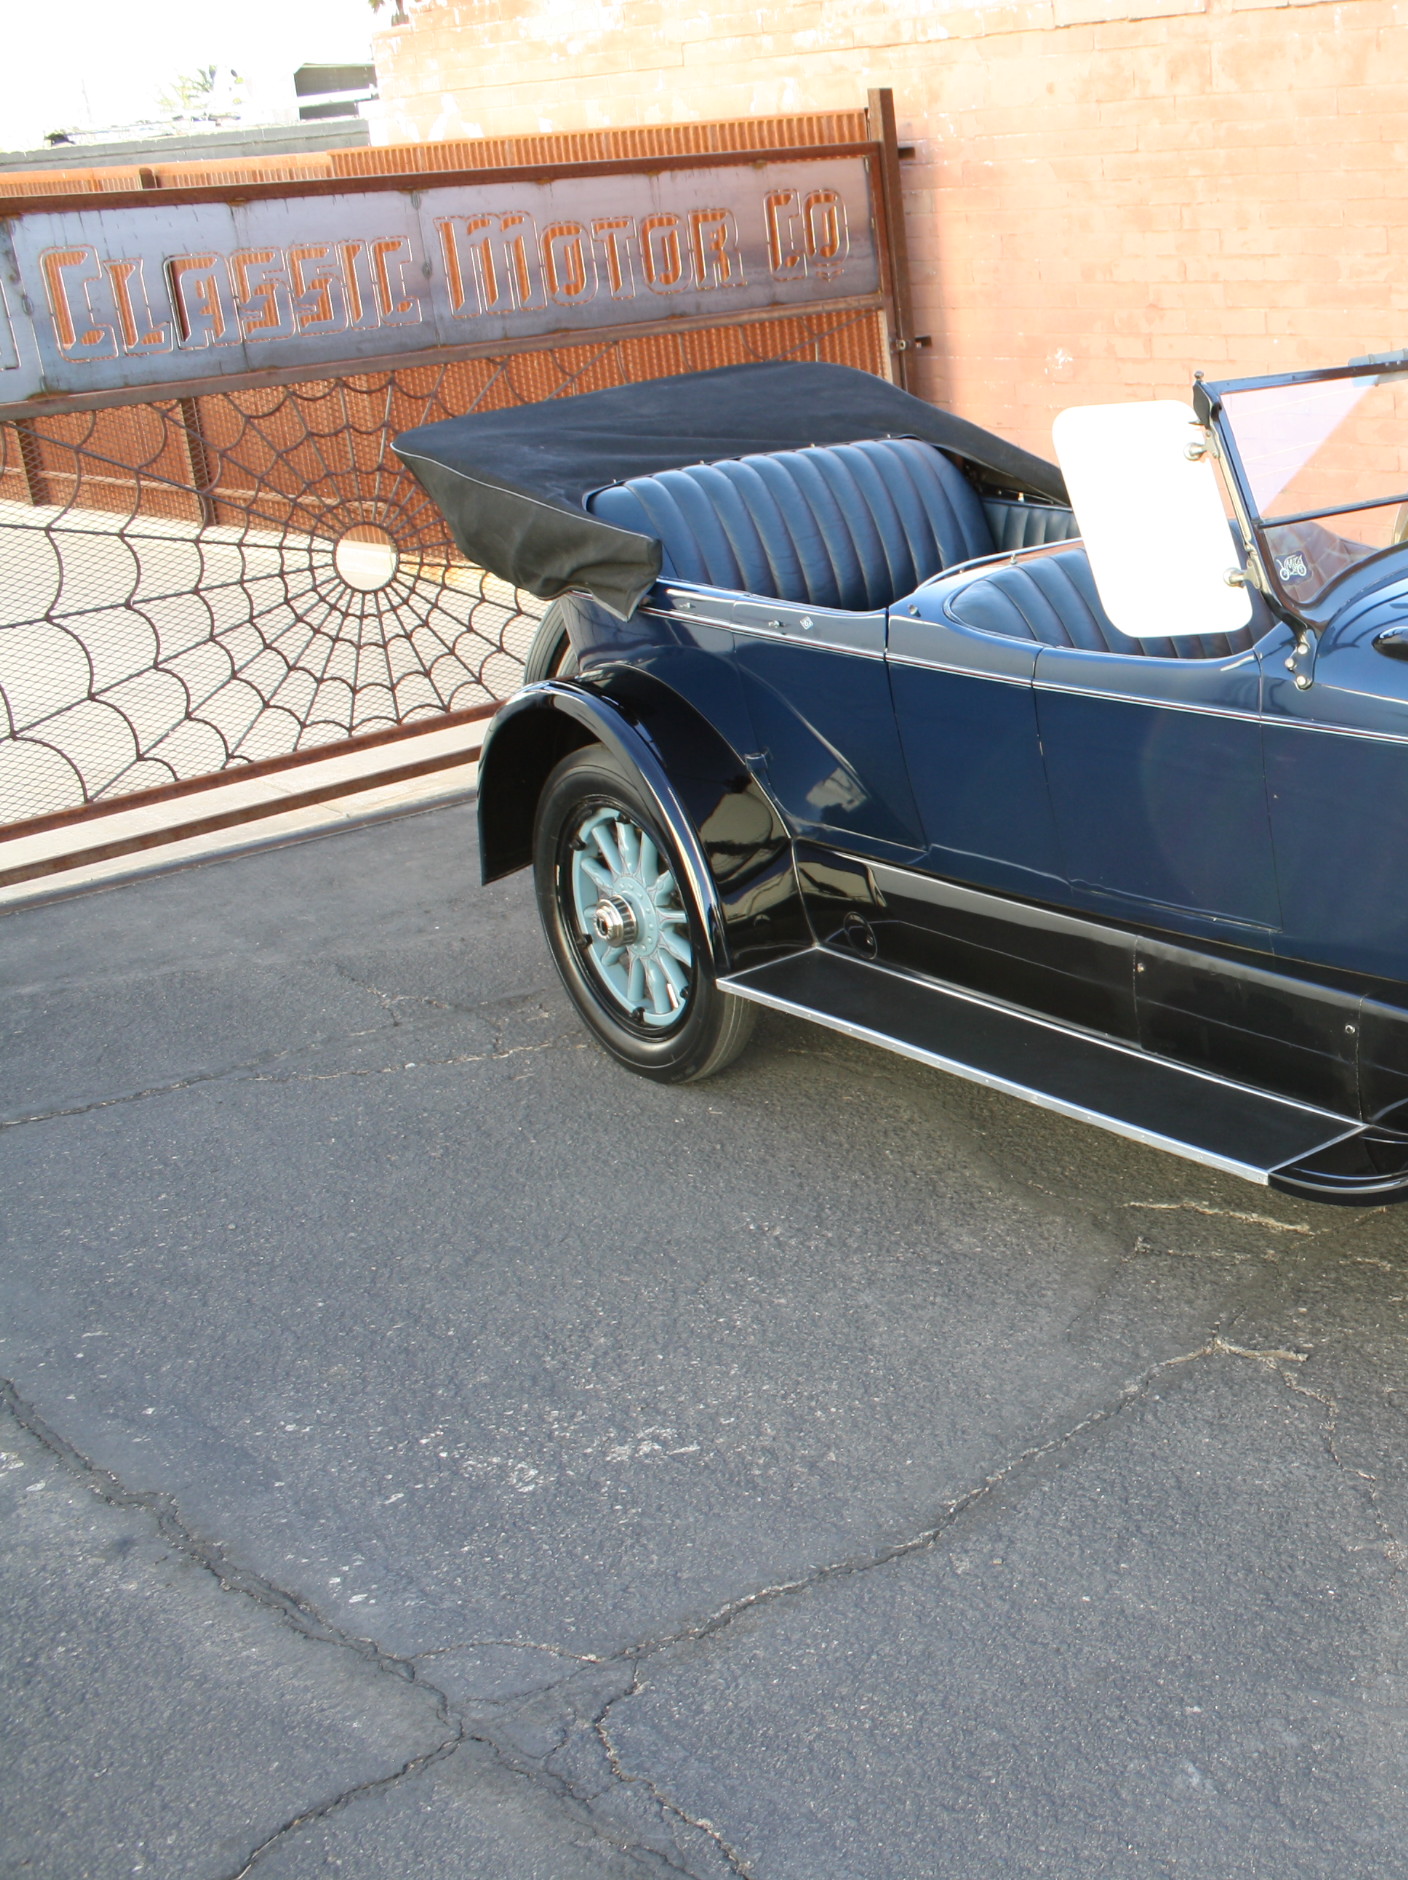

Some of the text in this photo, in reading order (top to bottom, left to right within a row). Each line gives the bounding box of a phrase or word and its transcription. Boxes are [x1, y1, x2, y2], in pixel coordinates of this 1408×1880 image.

[39, 235, 422, 363] CLASSIC
[433, 209, 748, 319] MOTOR
[763, 188, 850, 283] CO
